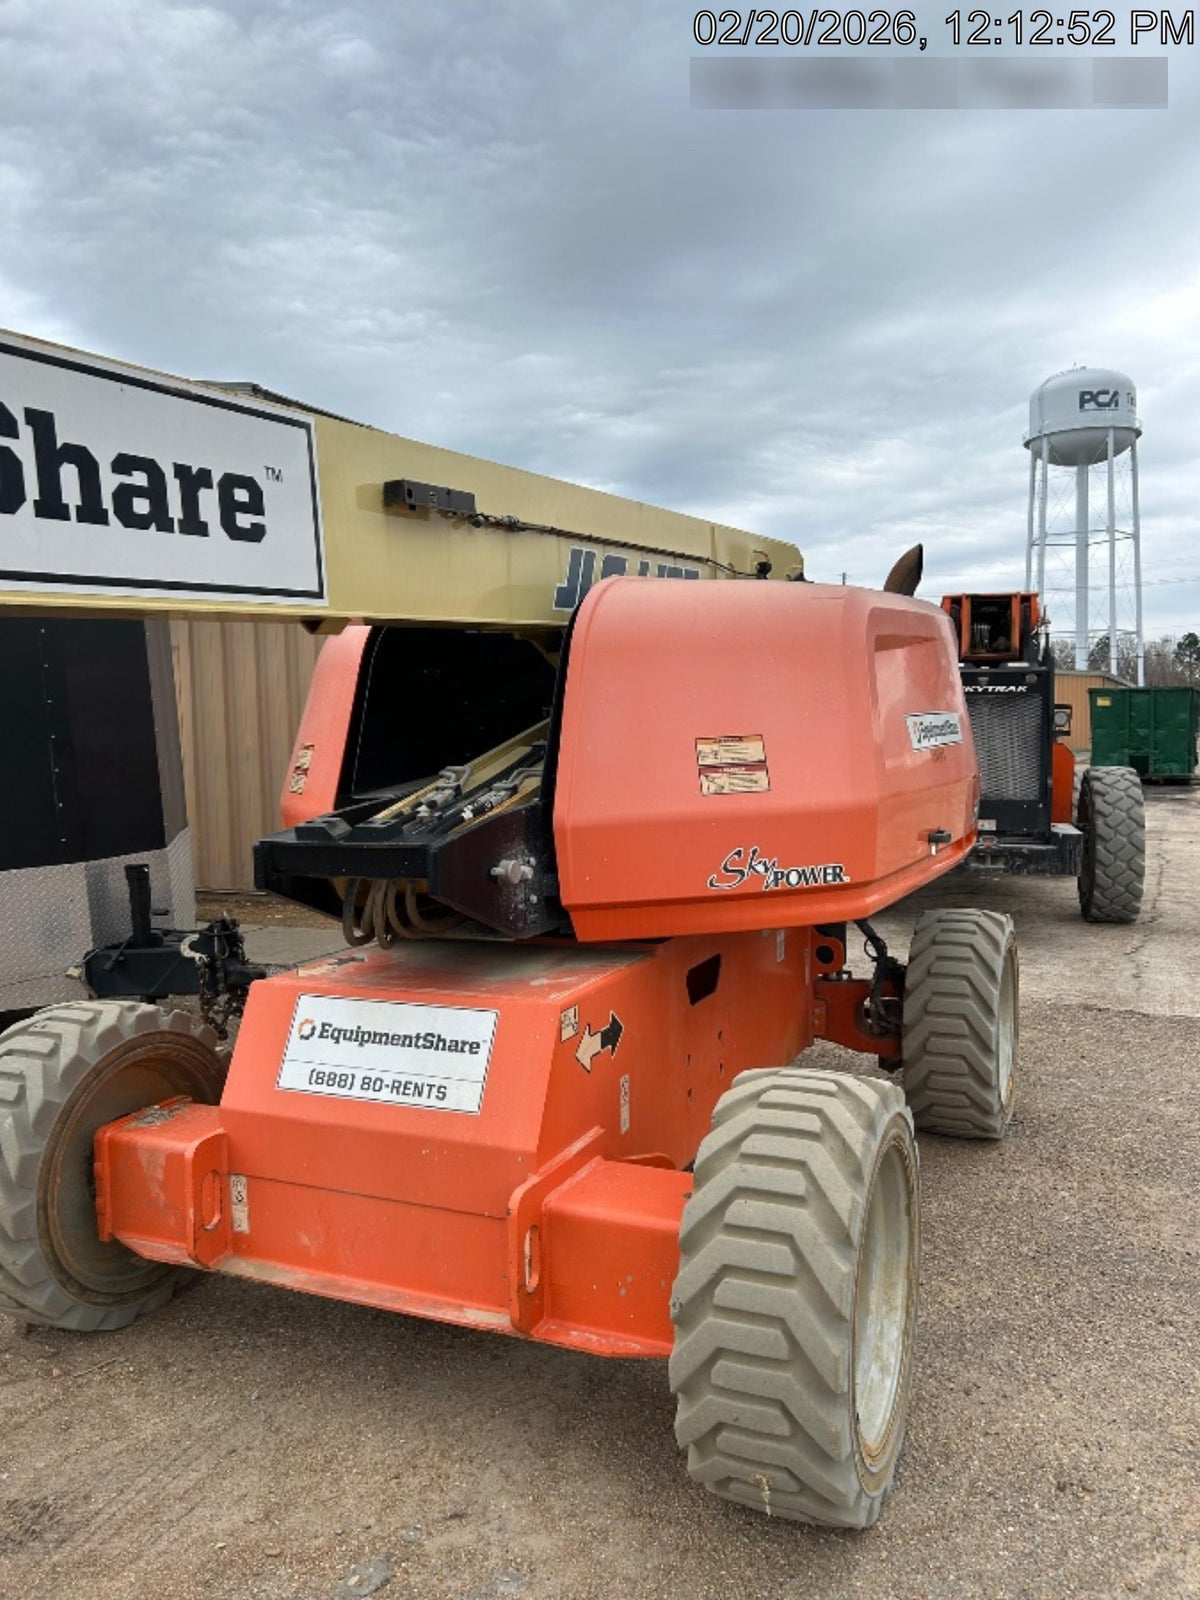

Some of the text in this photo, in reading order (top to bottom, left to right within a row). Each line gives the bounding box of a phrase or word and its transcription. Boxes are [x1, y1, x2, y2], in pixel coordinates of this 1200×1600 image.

[1079, 389, 1119, 409] PCA
[963, 685, 1027, 693] KYTRAK
[318, 1021, 481, 1055] EquipmentShare
[308, 1067, 448, 1102] (888) 80-RENTS
